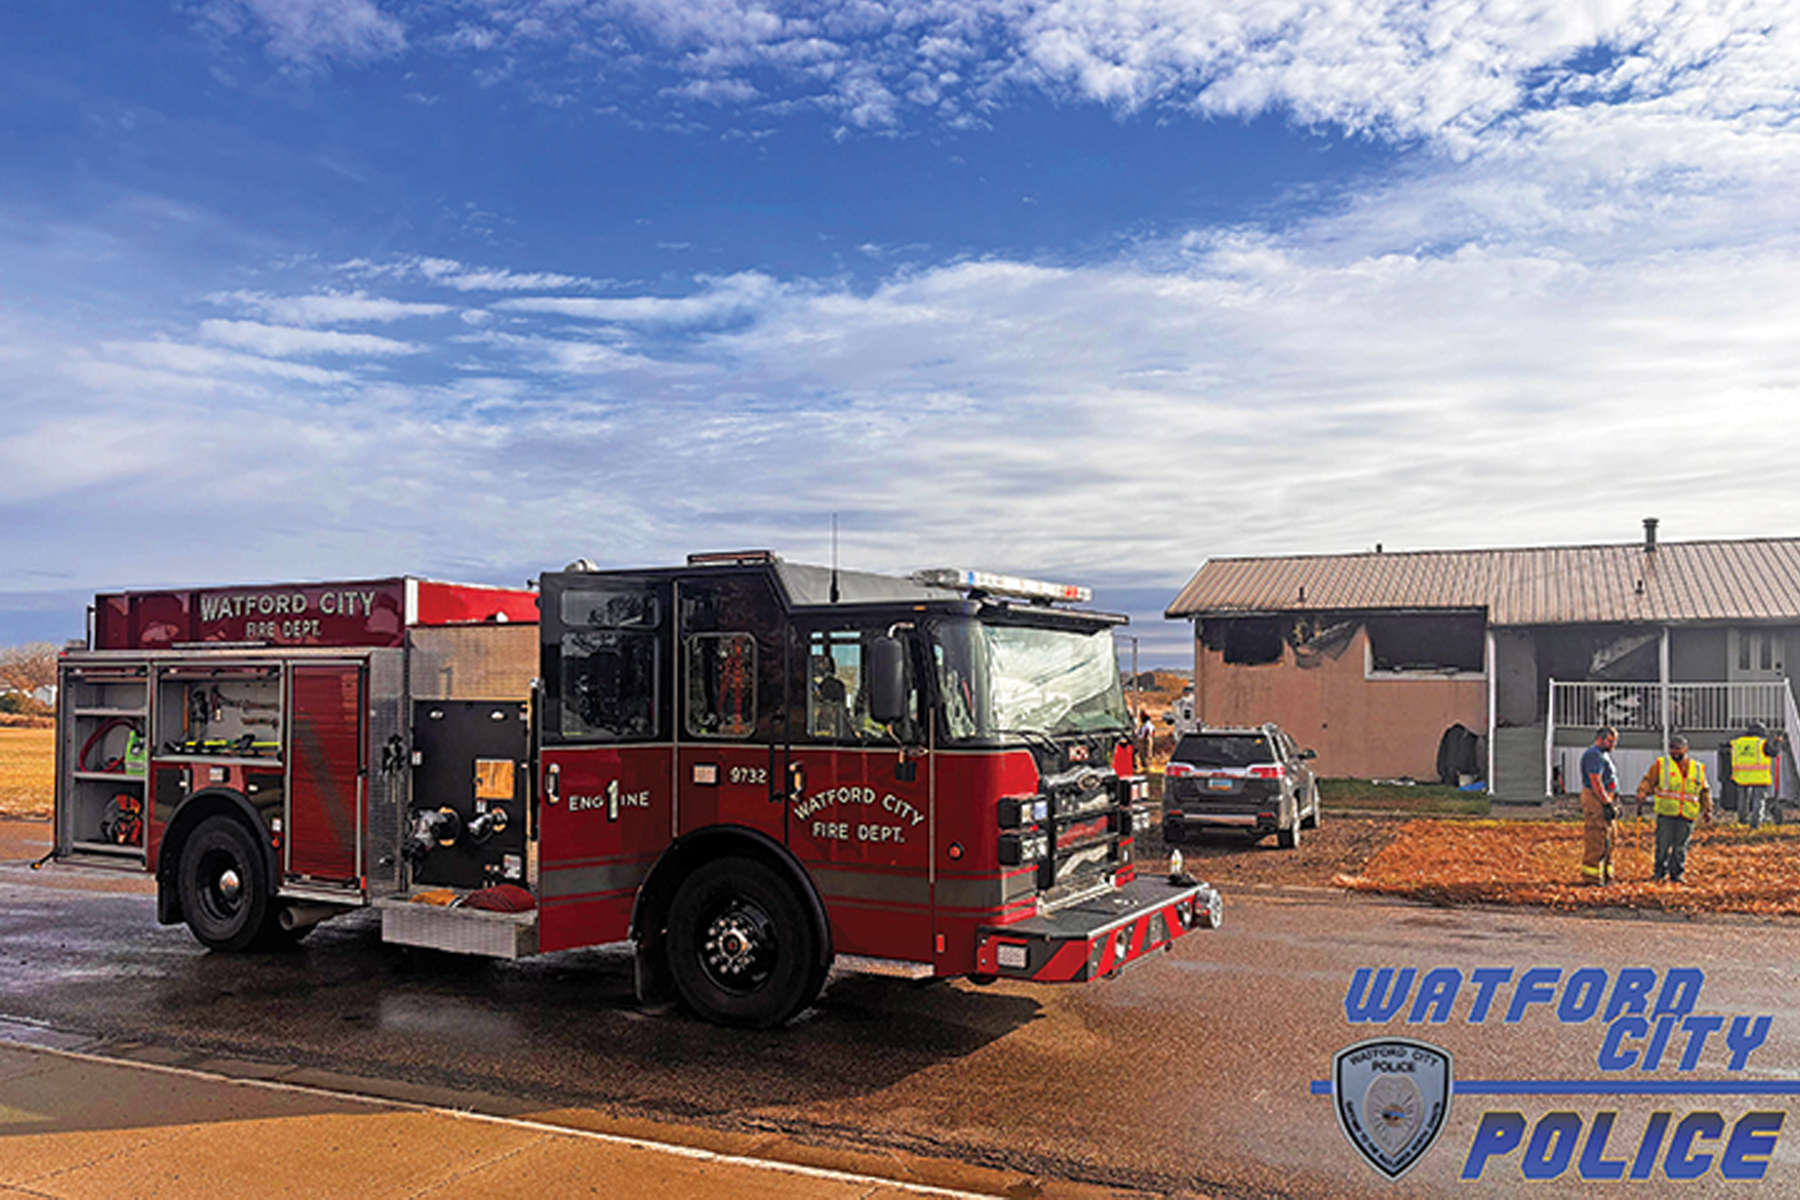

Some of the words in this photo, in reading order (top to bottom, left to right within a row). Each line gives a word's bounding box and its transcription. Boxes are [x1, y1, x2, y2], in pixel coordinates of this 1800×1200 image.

[201, 594, 307, 622] WATFORD
[319, 592, 375, 617] CITY
[246, 621, 275, 637] FIRE
[730, 766, 767, 784] 9732
[793, 786, 876, 820] WATFORD
[882, 794, 925, 826] CITY
[812, 822, 849, 839] FIRE
[857, 824, 905, 843] DEPT.
